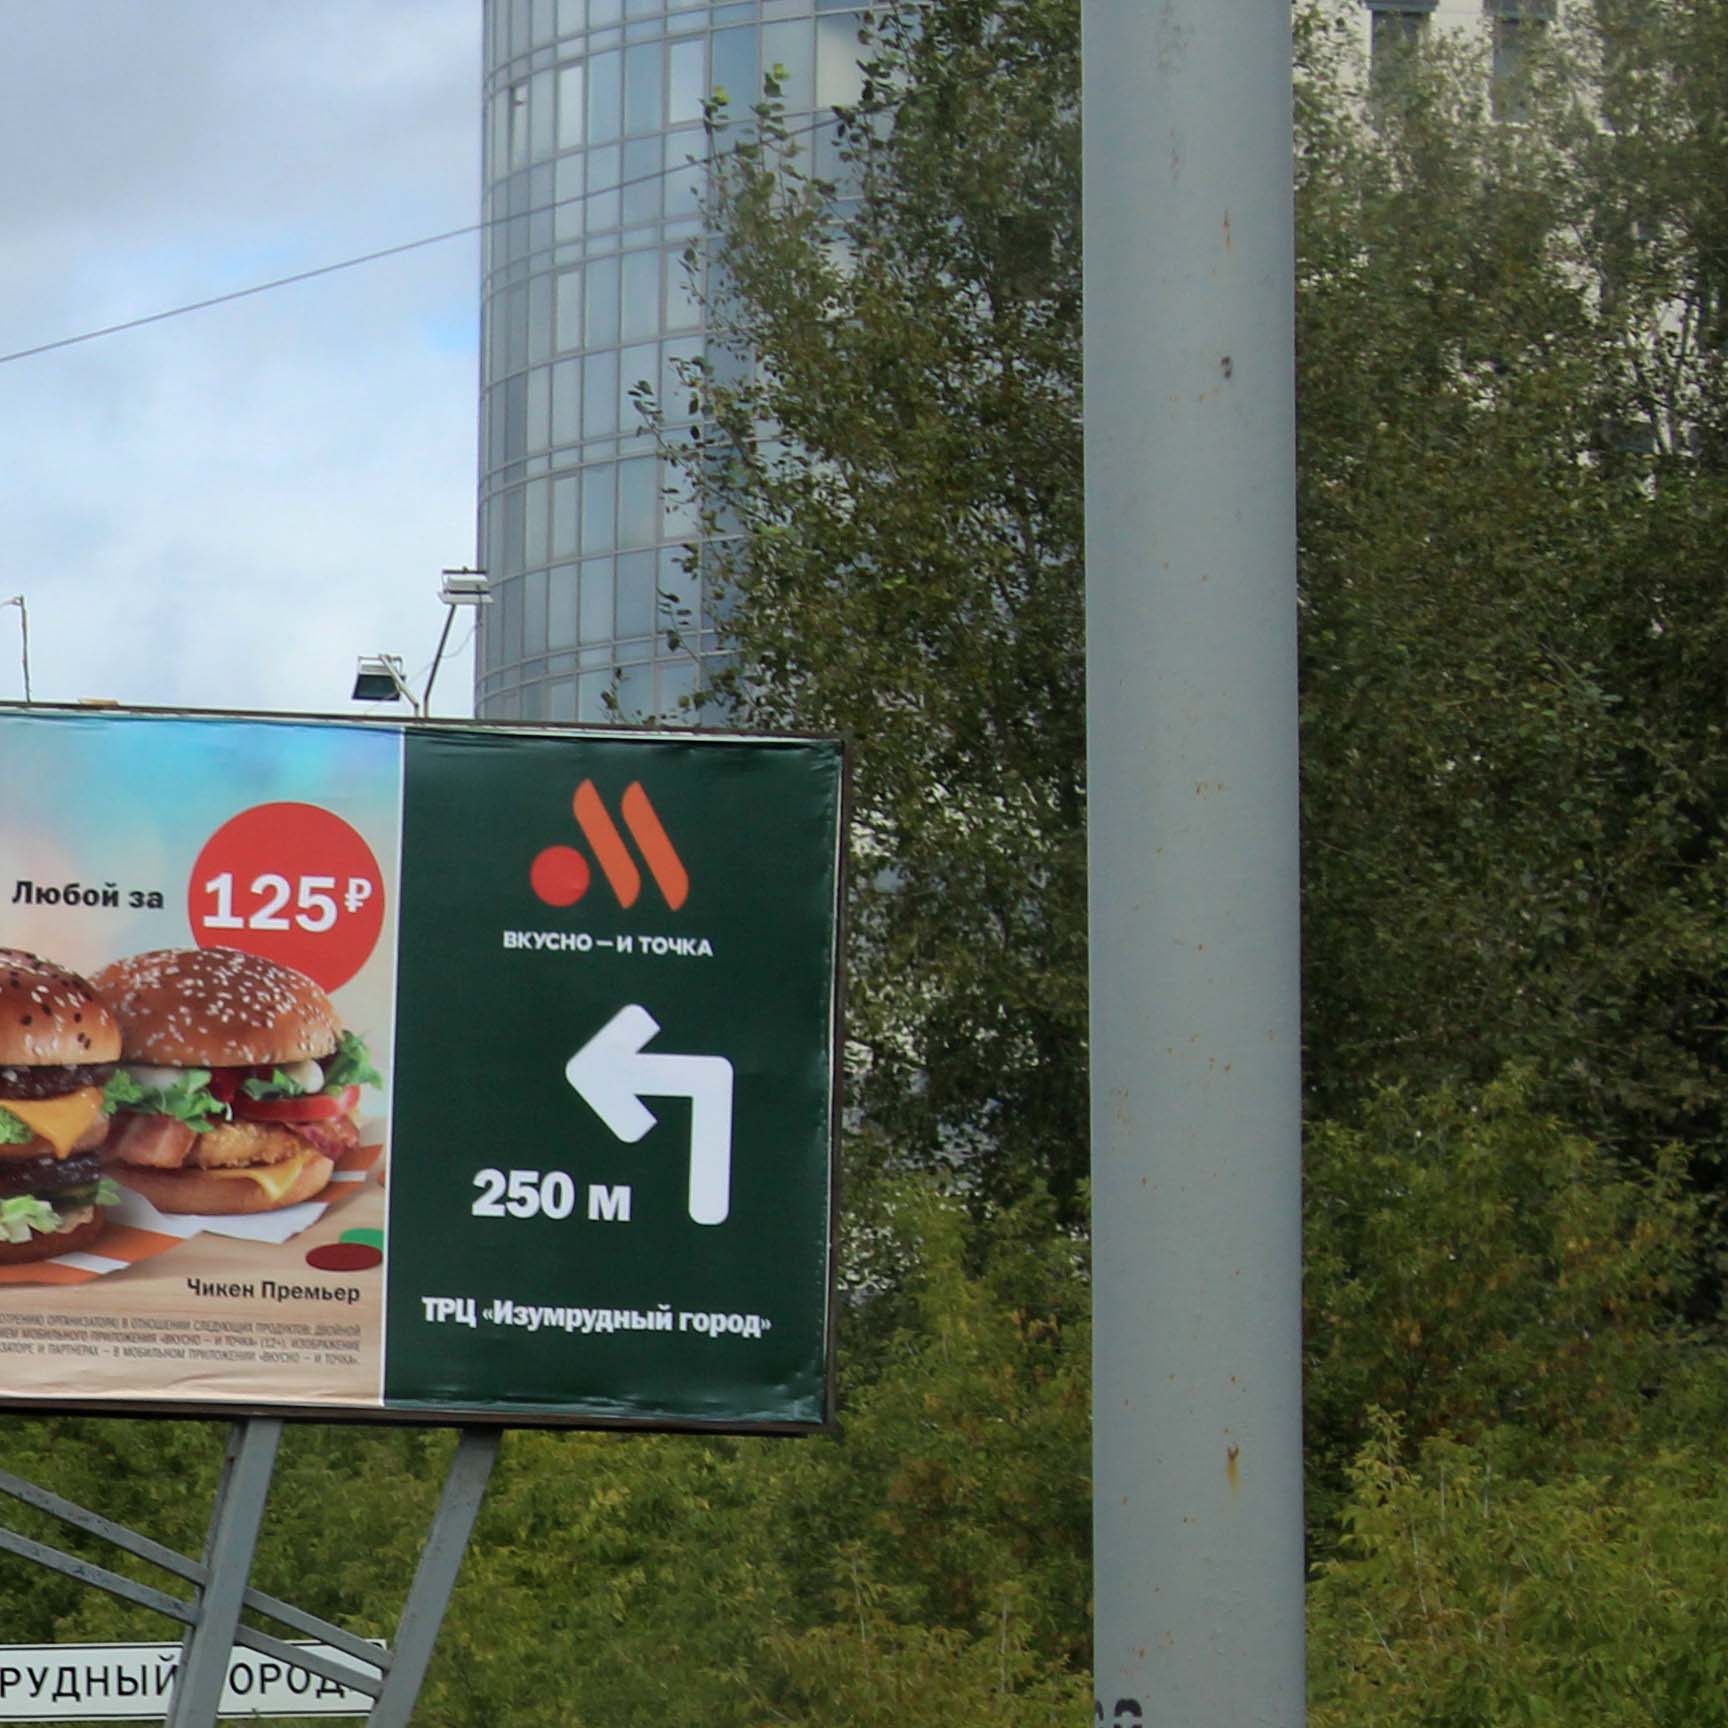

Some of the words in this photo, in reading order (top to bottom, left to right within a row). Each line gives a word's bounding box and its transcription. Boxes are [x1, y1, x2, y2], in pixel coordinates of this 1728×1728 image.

[11, 880, 120, 911] Любой
[129, 890, 165, 911] за
[502, 931, 592, 953] ВКУСНО
[617, 935, 632, 954] И
[637, 936, 714, 957] ТОЧКА
[470, 1168, 573, 1219] 250
[186, 1277, 254, 1300] Чикен
[261, 1280, 362, 1306] Премьер
[422, 1297, 477, 1328] ТРЦ
[482, 1298, 673, 1334] «Изумрудный
[678, 1308, 774, 1340] город»
